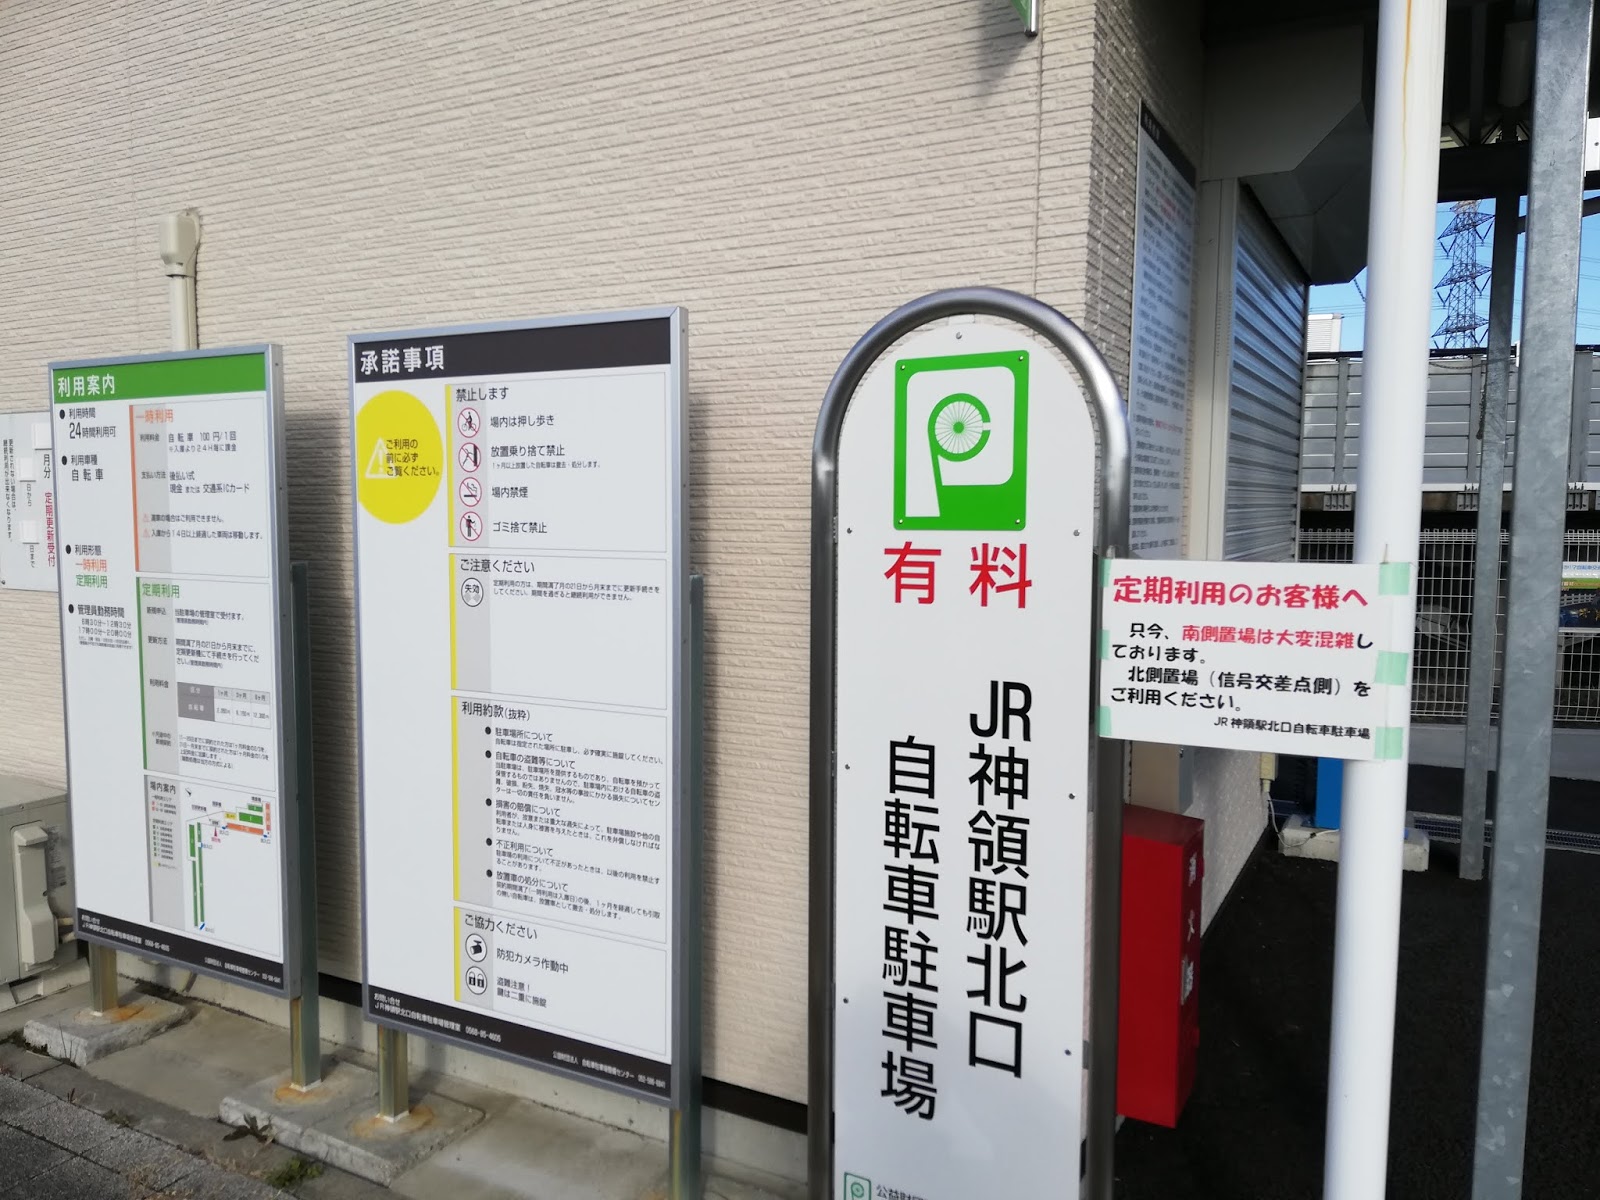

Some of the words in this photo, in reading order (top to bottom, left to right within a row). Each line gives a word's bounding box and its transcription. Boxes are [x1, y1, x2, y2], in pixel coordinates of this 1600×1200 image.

[360, 345, 445, 375] 承諾事項
[58, 374, 115, 397] 利用案内
[456, 387, 509, 402] 禁止します
[69, 407, 96, 420] 利用時間
[136, 408, 174, 424] 一時利用
[490, 415, 554, 428] 場内は押し歩き
[69, 422, 116, 440] 24時間利用可
[169, 432, 194, 443] 自転車
[386, 439, 419, 450] ご利用の
[491, 444, 566, 458] 放置乗り捨て禁止
[71, 454, 98, 466] 利用車種
[386, 453, 419, 464] 前に必ず
[71, 468, 104, 482] 自転車
[170, 470, 195, 481] 後払い式
[386, 466, 440, 477] ご覧ください。
[170, 484, 183, 494] 現金
[203, 483, 250, 494] 交通系ICカード
[491, 487, 529, 499] 場内禁煙
[493, 521, 549, 534] ゴミ捨て禁止
[76, 559, 107, 573] 一時利用
[460, 558, 536, 574] ご注意ください
[76, 574, 108, 589] 定期利用
[884, 541, 1033, 609] 有料
[143, 583, 181, 598] 定期利用
[465, 584, 480, 594] 失効
[1113, 575, 1369, 610] 定期利用のお客様へ
[78, 603, 125, 619] 管理員勤務時間
[1130, 622, 1374, 650] 只今、南側置場は大変混雑し
[1112, 644, 1206, 665] ております。
[1112, 687, 1241, 712] ご利用ください。
[461, 701, 530, 721] 利用約款(抜粋)
[495, 727, 554, 743] 駐車場所について
[495, 751, 576, 770] 自転車の盗難等について
[150, 781, 176, 795] 場内案内
[495, 799, 560, 817] 損害の賠償について
[495, 840, 553, 857] 不正利用について
[496, 871, 568, 891] 放置車の処分について
[967, 681, 1032, 1079] JR神領駅北口
[465, 913, 538, 939] ご協力ください
[881, 735, 940, 1121] 自転車駐車場
[496, 948, 569, 975] 防犯カメラ作動中
[497, 987, 547, 1008] 鍵は二重に施錠
